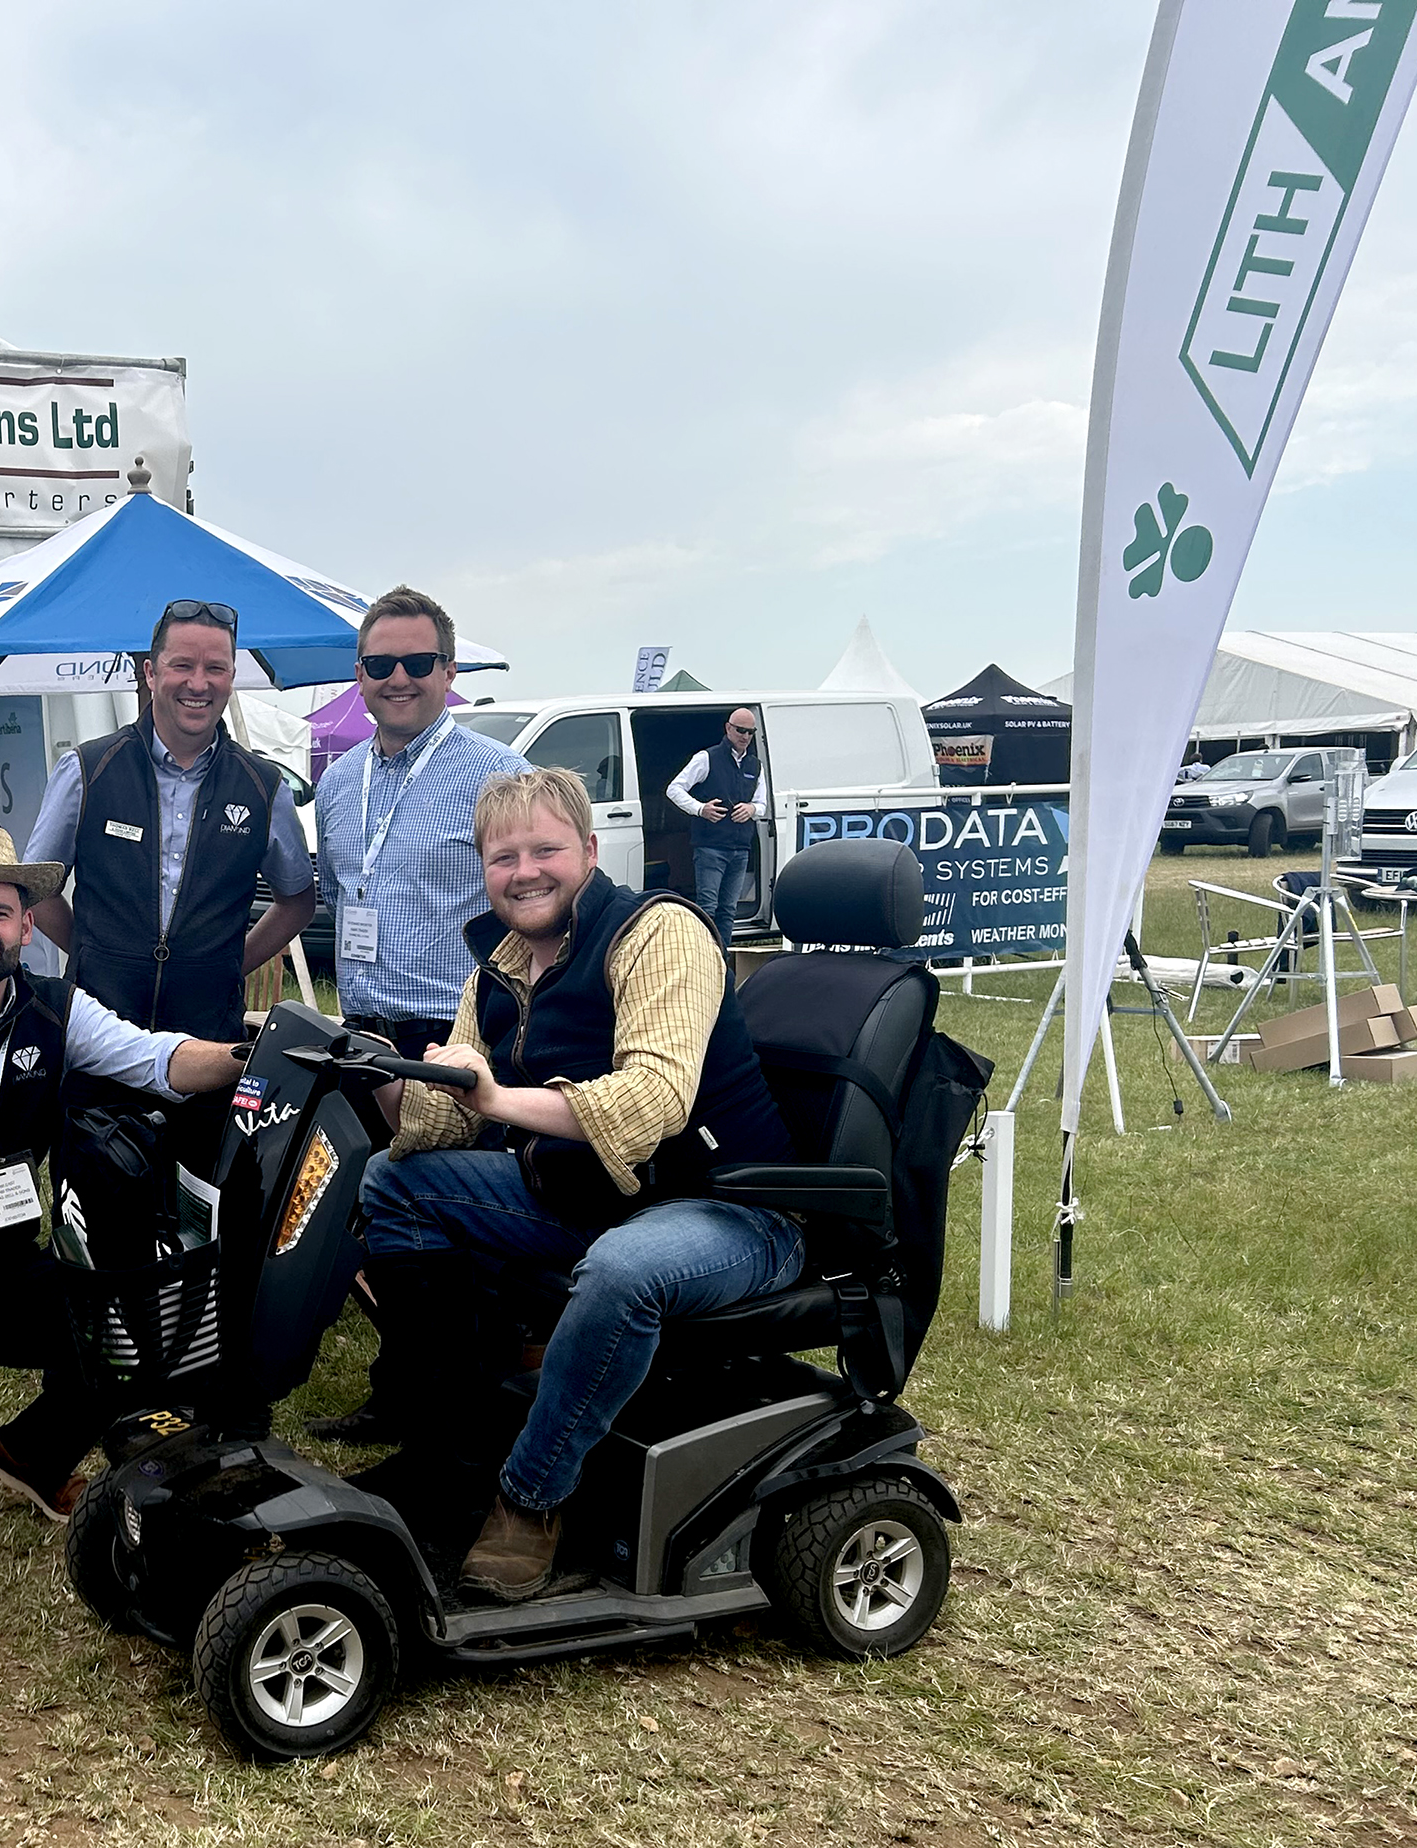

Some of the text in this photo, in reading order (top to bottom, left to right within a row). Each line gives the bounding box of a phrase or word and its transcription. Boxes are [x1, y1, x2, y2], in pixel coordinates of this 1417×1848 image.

[1208, 170, 1324, 374] LITH
[51, 401, 121, 450] Ltd
[1004, 720, 1026, 729] SOLAR
[1042, 720, 1071, 729] BATTERY
[932, 742, 986, 757] Phoenix
[802, 807, 1049, 850] PRODATA
[935, 856, 1049, 881] SYSTEMS
[972, 889, 998, 907] FOR
[971, 925, 1036, 945] WEATHER
[234, 1102, 301, 1137] Vita
[138, 1409, 191, 1437] P32
